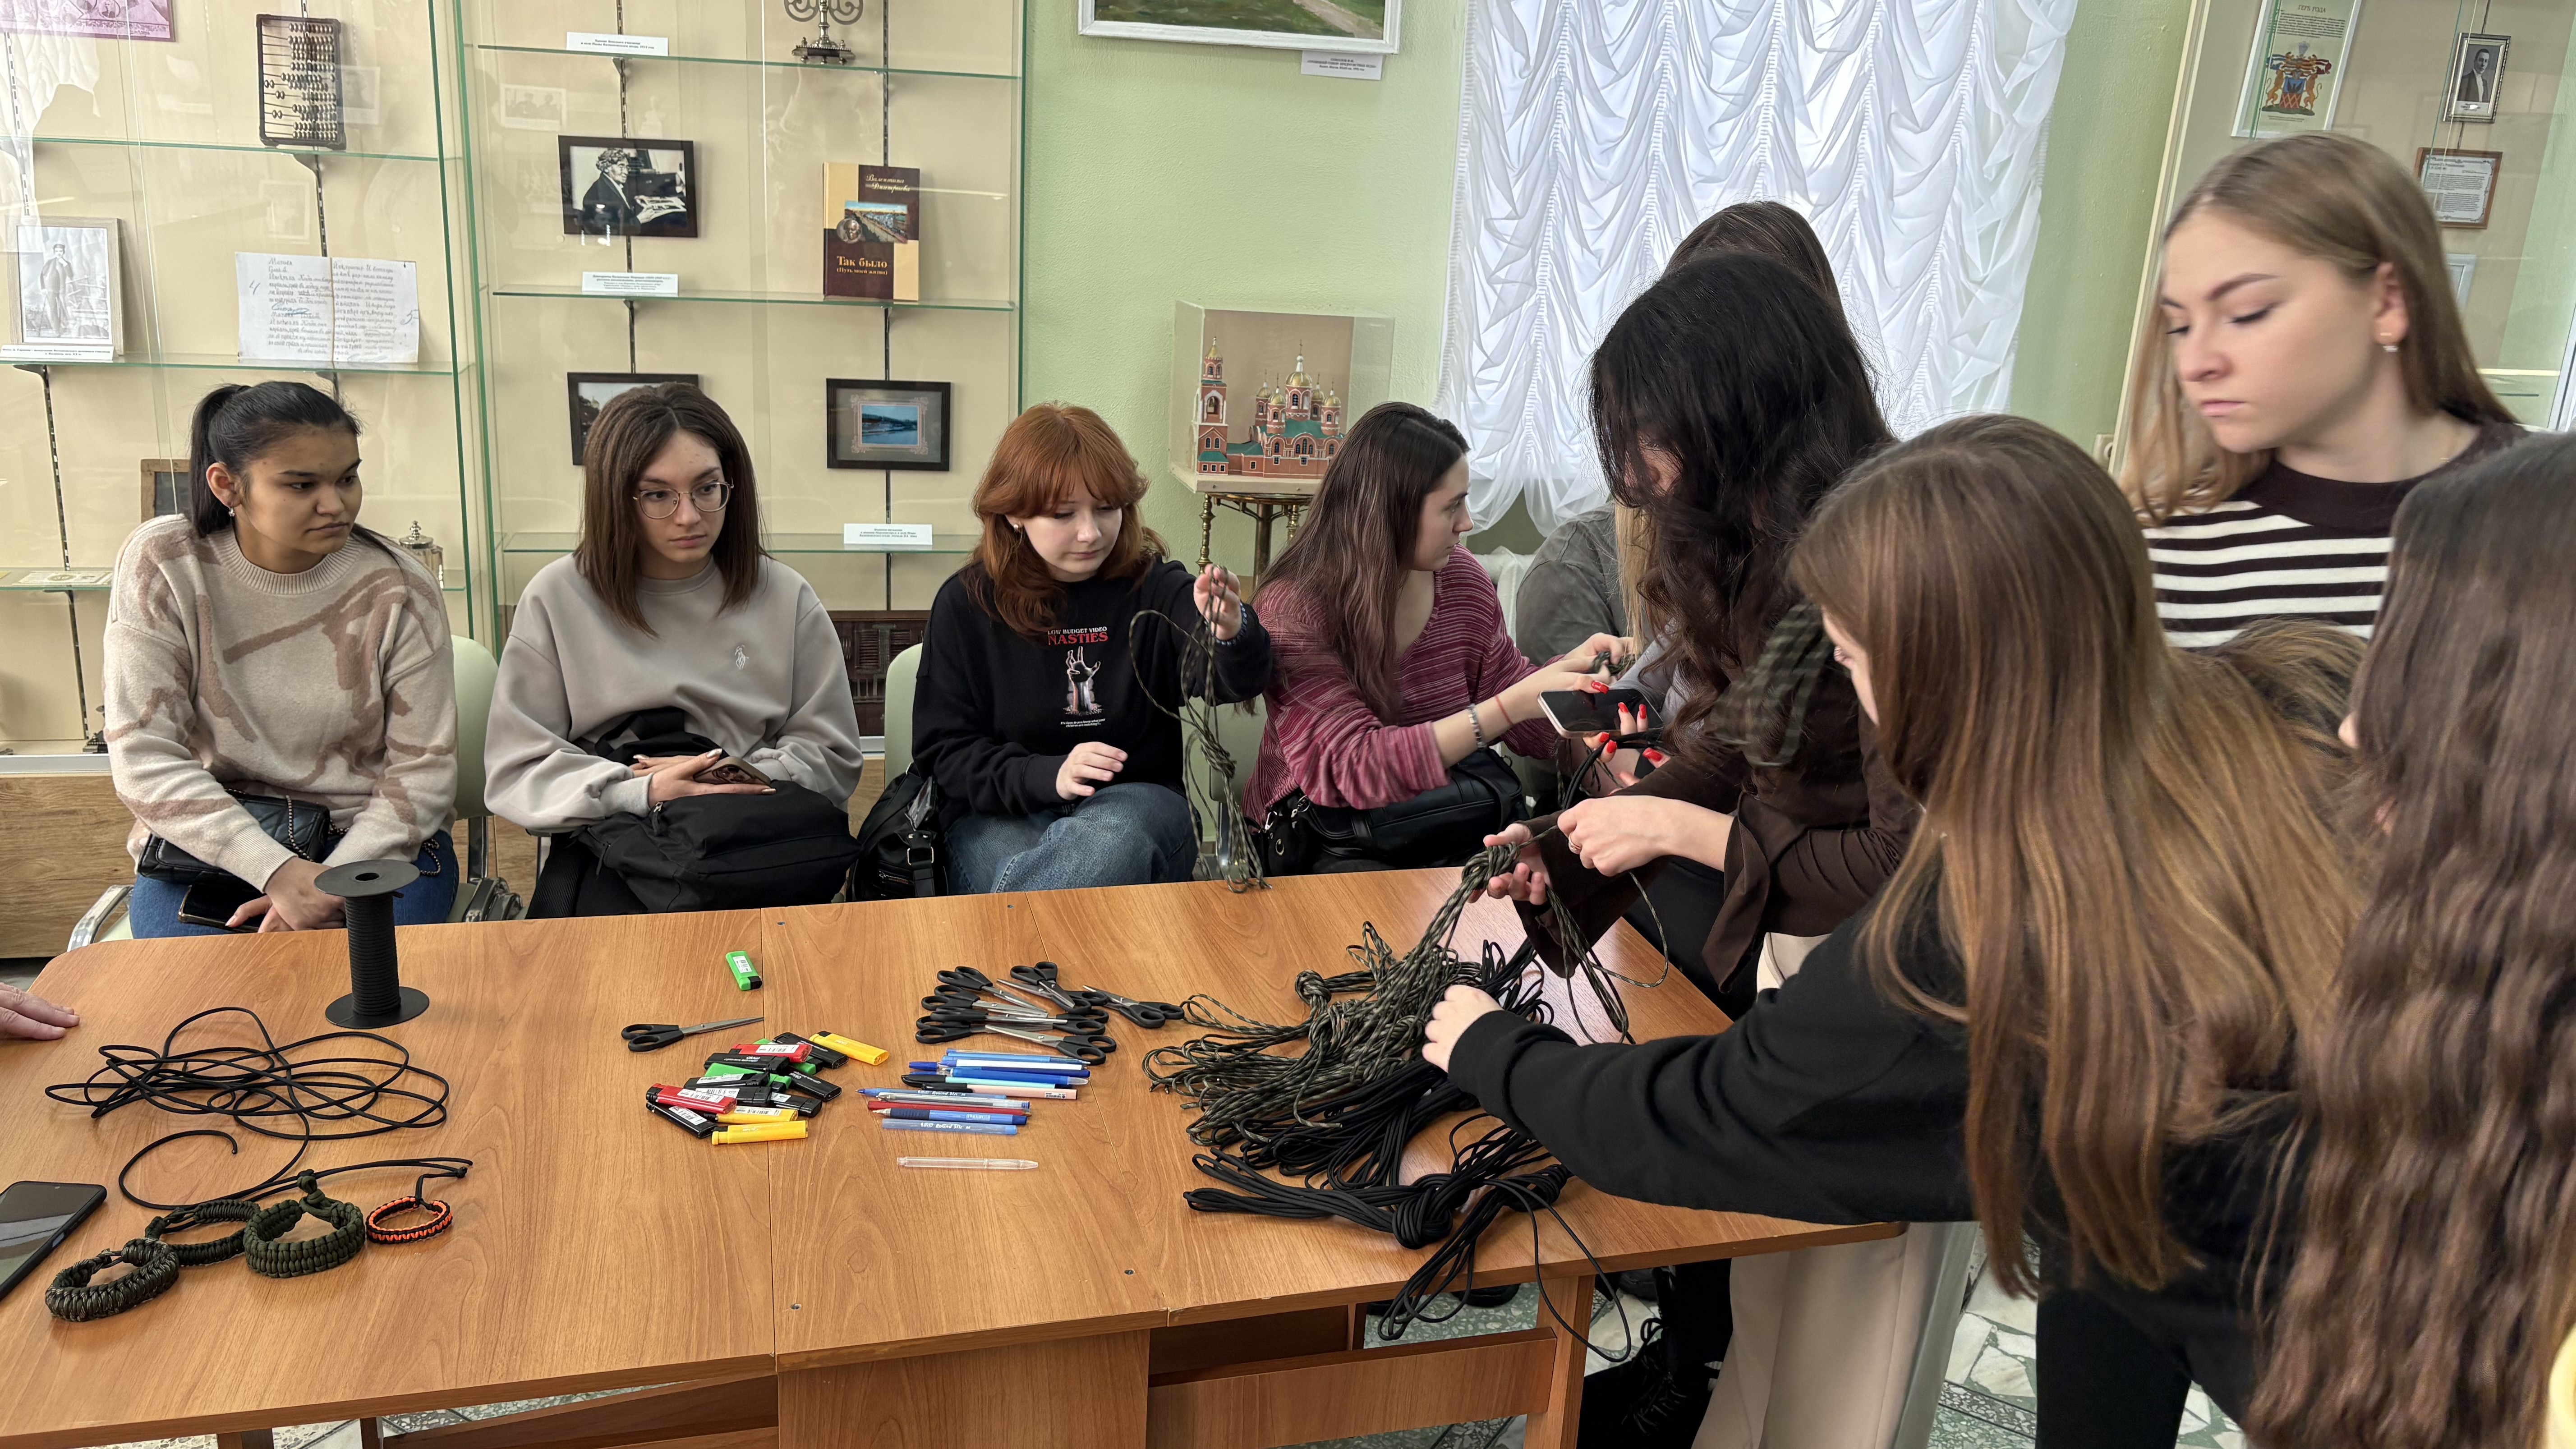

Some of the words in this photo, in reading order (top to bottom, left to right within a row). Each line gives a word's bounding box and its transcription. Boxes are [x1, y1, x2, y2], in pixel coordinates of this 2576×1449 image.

[837, 256, 856, 266] Так
[859, 258, 888, 268] было
[1048, 632, 1108, 645] NASTIES
